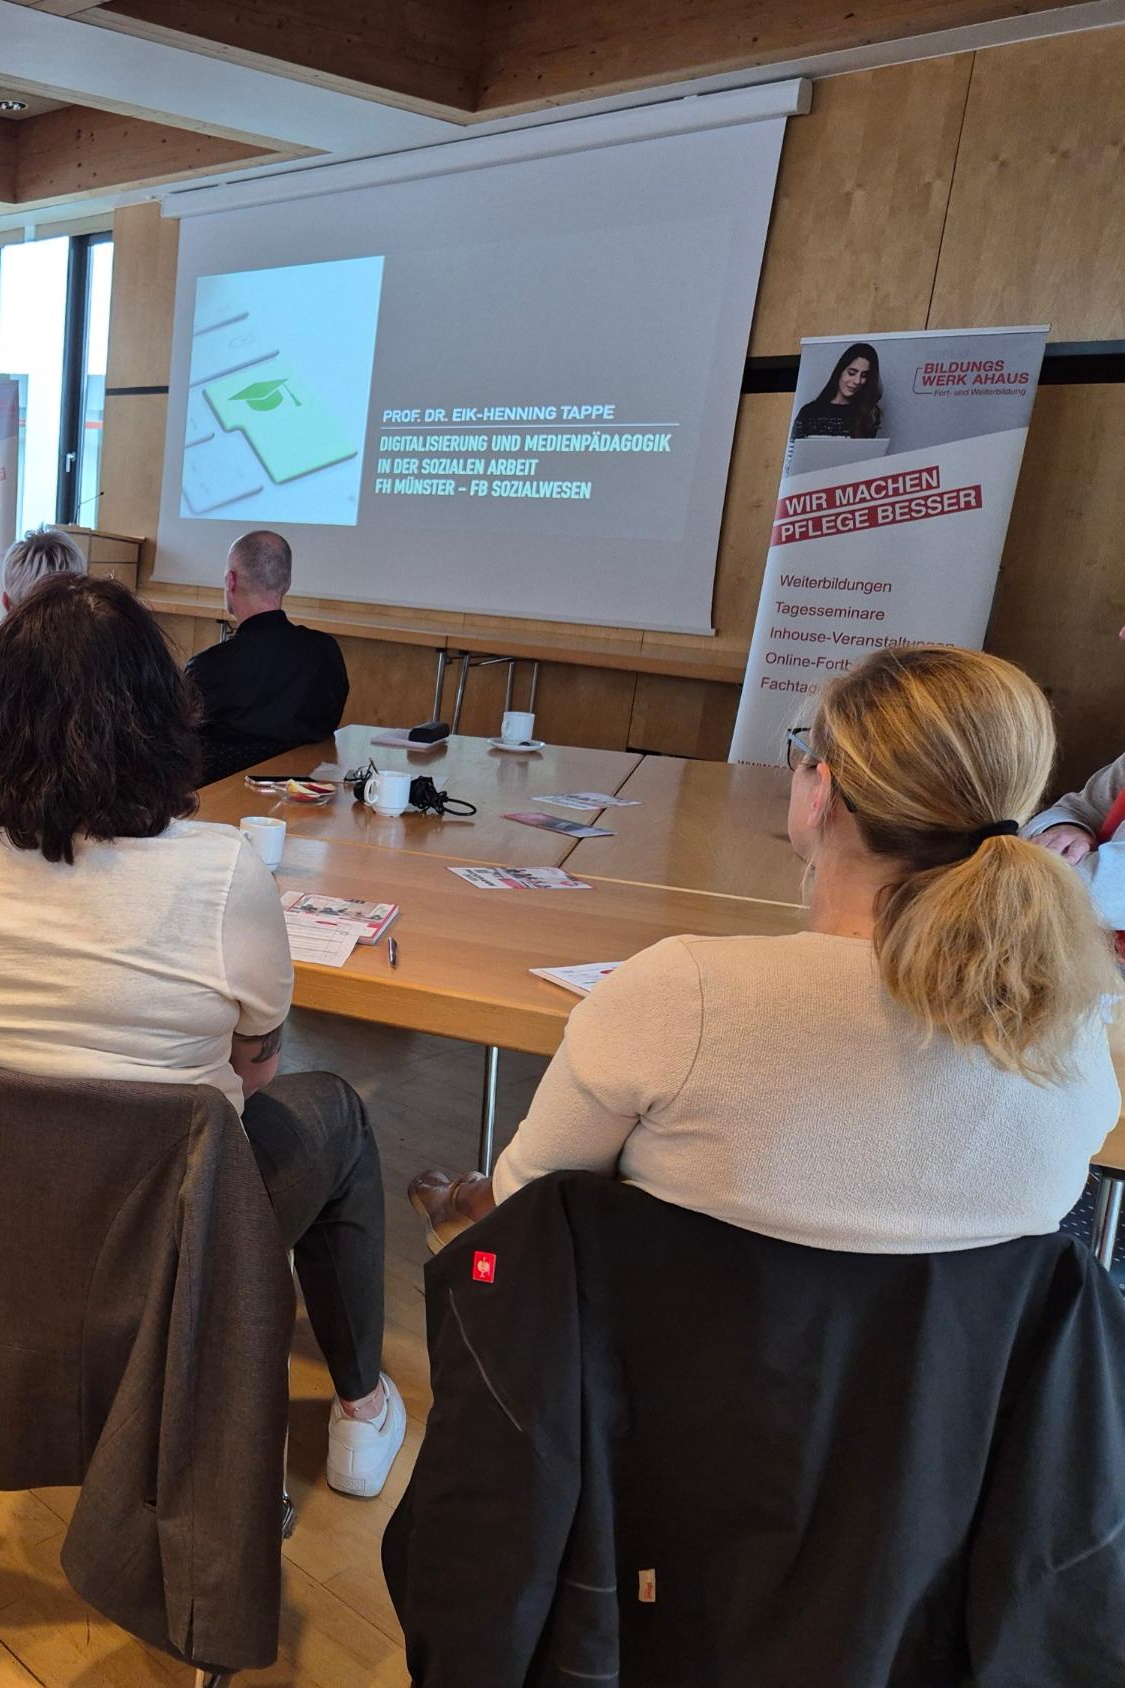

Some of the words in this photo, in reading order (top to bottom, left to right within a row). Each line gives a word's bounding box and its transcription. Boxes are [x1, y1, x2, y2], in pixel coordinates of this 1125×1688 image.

[924, 360, 1005, 374] BILDUNGS
[922, 374, 968, 386] WERK
[972, 372, 1029, 385] AHAUS
[971, 387, 1026, 396] Weiterbildung
[382, 410, 421, 423] PROF.
[424, 409, 448, 422] DR.
[452, 406, 557, 421] EIK-HENNING
[561, 405, 615, 420] TAPPE
[379, 434, 488, 452] DIGITALISIERUNG
[491, 435, 521, 452] UND
[524, 431, 672, 453] MEDIENPÄDAGOGIK
[377, 459, 392, 474] IN
[393, 459, 419, 475] DER
[420, 459, 484, 476] SOZIALEN
[486, 459, 539, 477] ARBEIT
[375, 479, 392, 494] FH
[394, 477, 455, 496] MÜNSTER
[470, 481, 488, 496] FB
[491, 481, 592, 500] SOZIALWESEN
[785, 492, 828, 516] WIR
[834, 470, 939, 508] MACHEN
[780, 511, 870, 542] PFLEGE
[877, 488, 976, 526] BESSER
[780, 575, 892, 595] Weiterbildungen
[775, 601, 885, 621] Tagesseminare
[765, 652, 852, 671] Online-Fortb
[760, 677, 821, 696] Fachtag
